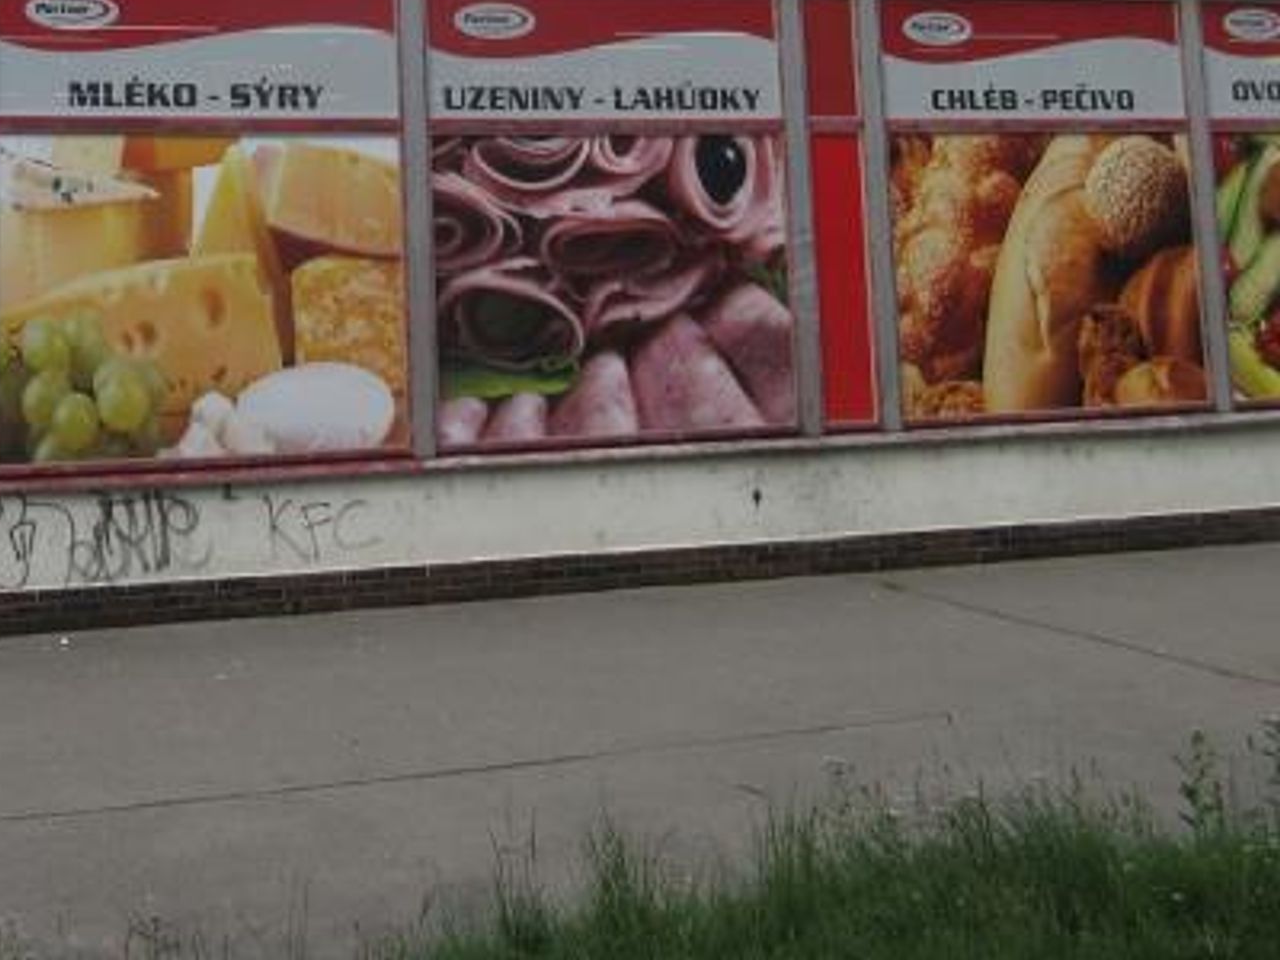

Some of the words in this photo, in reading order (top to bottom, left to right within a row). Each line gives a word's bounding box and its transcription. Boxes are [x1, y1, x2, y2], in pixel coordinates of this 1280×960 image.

[68, 76, 197, 108] MLÉKO
[230, 76, 323, 109] SÝRY
[444, 86, 585, 110] UZENINY
[931, 82, 1018, 110] CHLÉB
[1042, 83, 1134, 110] PEČIVO
[263, 494, 383, 564] KFC
